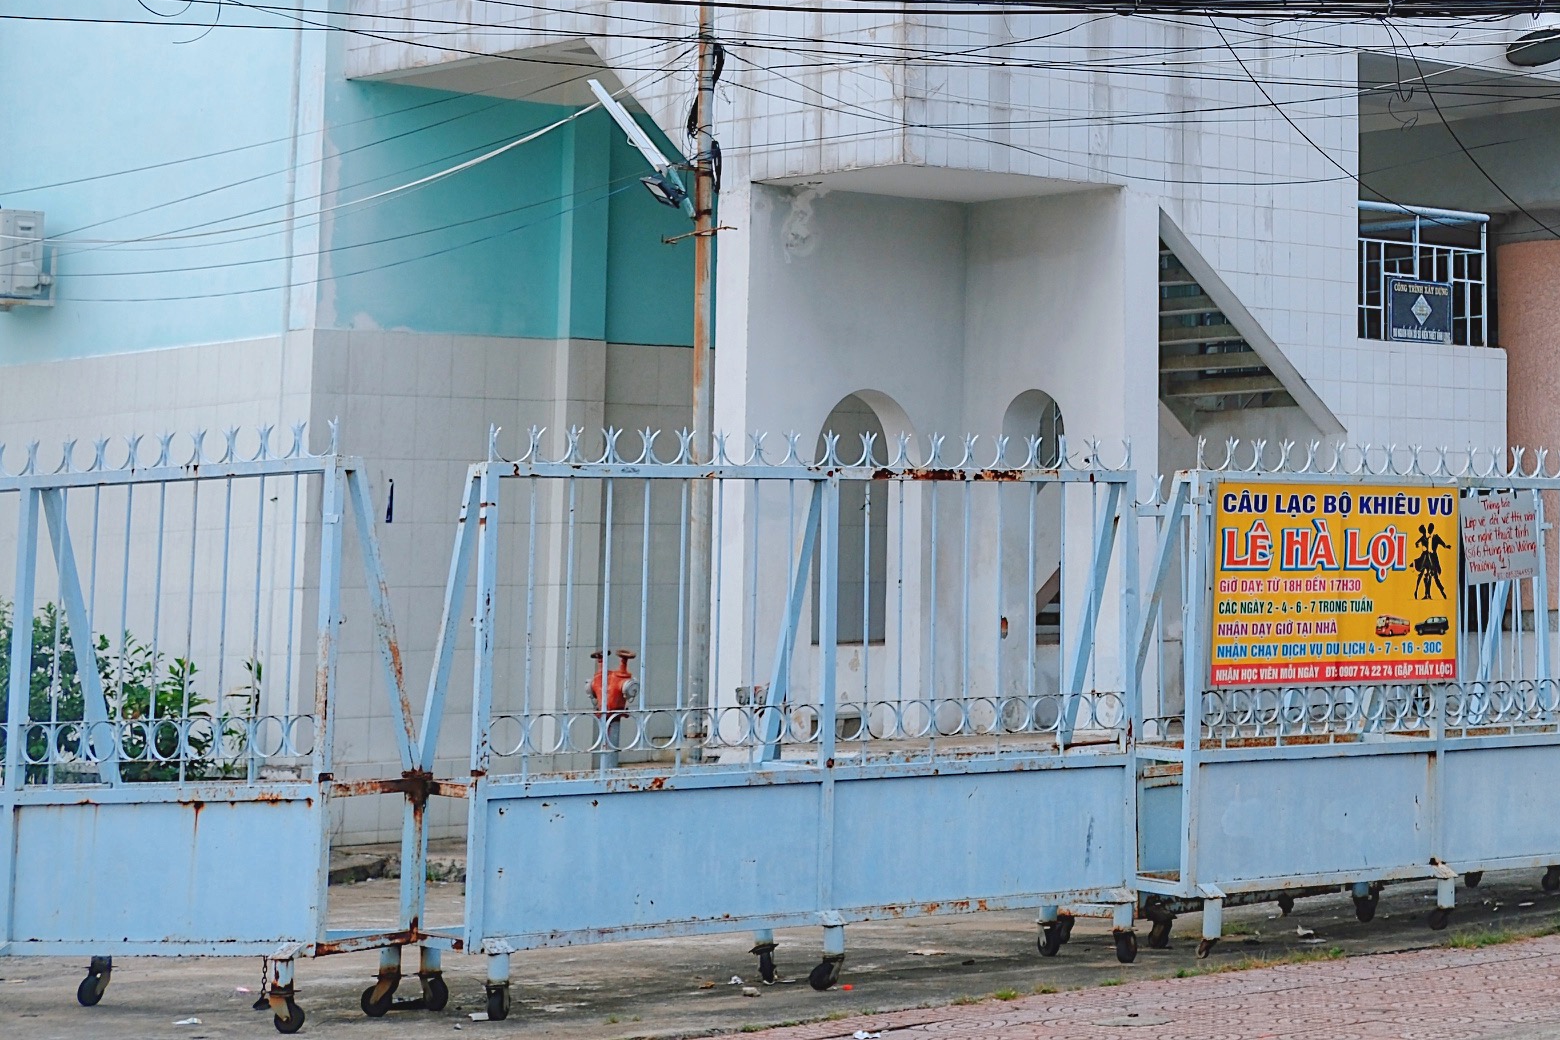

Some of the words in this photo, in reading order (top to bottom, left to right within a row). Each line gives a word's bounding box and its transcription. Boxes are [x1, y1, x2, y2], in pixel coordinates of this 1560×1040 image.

[1394, 282, 1408, 292] CÔNG
[1408, 284, 1423, 294] TRÌNH
[1424, 285, 1434, 295] XÂY
[1223, 490, 1268, 513] CÂU
[1275, 494, 1316, 517] LẠC
[1323, 492, 1352, 518] BỘ
[1359, 493, 1420, 515] KHIÊU
[1427, 494, 1453, 515] VŨ
[1221, 519, 1274, 571] LÊ
[1280, 518, 1340, 571] HÀ
[1344, 524, 1407, 583] LỢI
[1241, 580, 1263, 595] DẠY:
[1267, 577, 1281, 592] TỪ
[1283, 580, 1302, 592] 18H
[1305, 575, 1326, 592] ĐẾN
[1330, 579, 1361, 591] 17H30
[1219, 599, 1237, 614] CÁC
[1240, 599, 1265, 614] NGÀY
[1267, 601, 1273, 614] 2
[1282, 601, 1287, 613] 4
[1296, 601, 1302, 613] 6
[1310, 601, 1316, 613] 7
[1319, 600, 1347, 613] TRONG
[1218, 621, 1248, 639] NHẬN
[1252, 623, 1272, 638] DẠY
[1276, 619, 1294, 635] GIỜ
[1297, 622, 1312, 638] TẠI
[1315, 619, 1337, 634] NHÀ
[1217, 642, 1247, 660] NHẬN
[1251, 644, 1278, 660] CHẠY
[1282, 643, 1306, 659] DỊCH
[1310, 643, 1323, 658] VỤ
[1326, 642, 1339, 655] DU
[1343, 642, 1366, 657] LỊCH
[1369, 642, 1375, 654] 4
[1385, 642, 1391, 654] 7
[1402, 642, 1413, 653] 16
[1423, 641, 1442, 653] 30C
[1216, 667, 1239, 683] NHẬN
[1241, 668, 1258, 682] HỌC
[1260, 665, 1278, 679] VIÊN
[1297, 665, 1319, 678] NGÀY
[1326, 666, 1338, 677] ĐT:
[1339, 666, 1358, 677] 0907
[1360, 666, 1370, 676] 74
[1371, 665, 1381, 676] 22
[1383, 665, 1392, 676] 74
[1394, 663, 1413, 678] (GẶP
[1436, 662, 1452, 677] LỘC)
